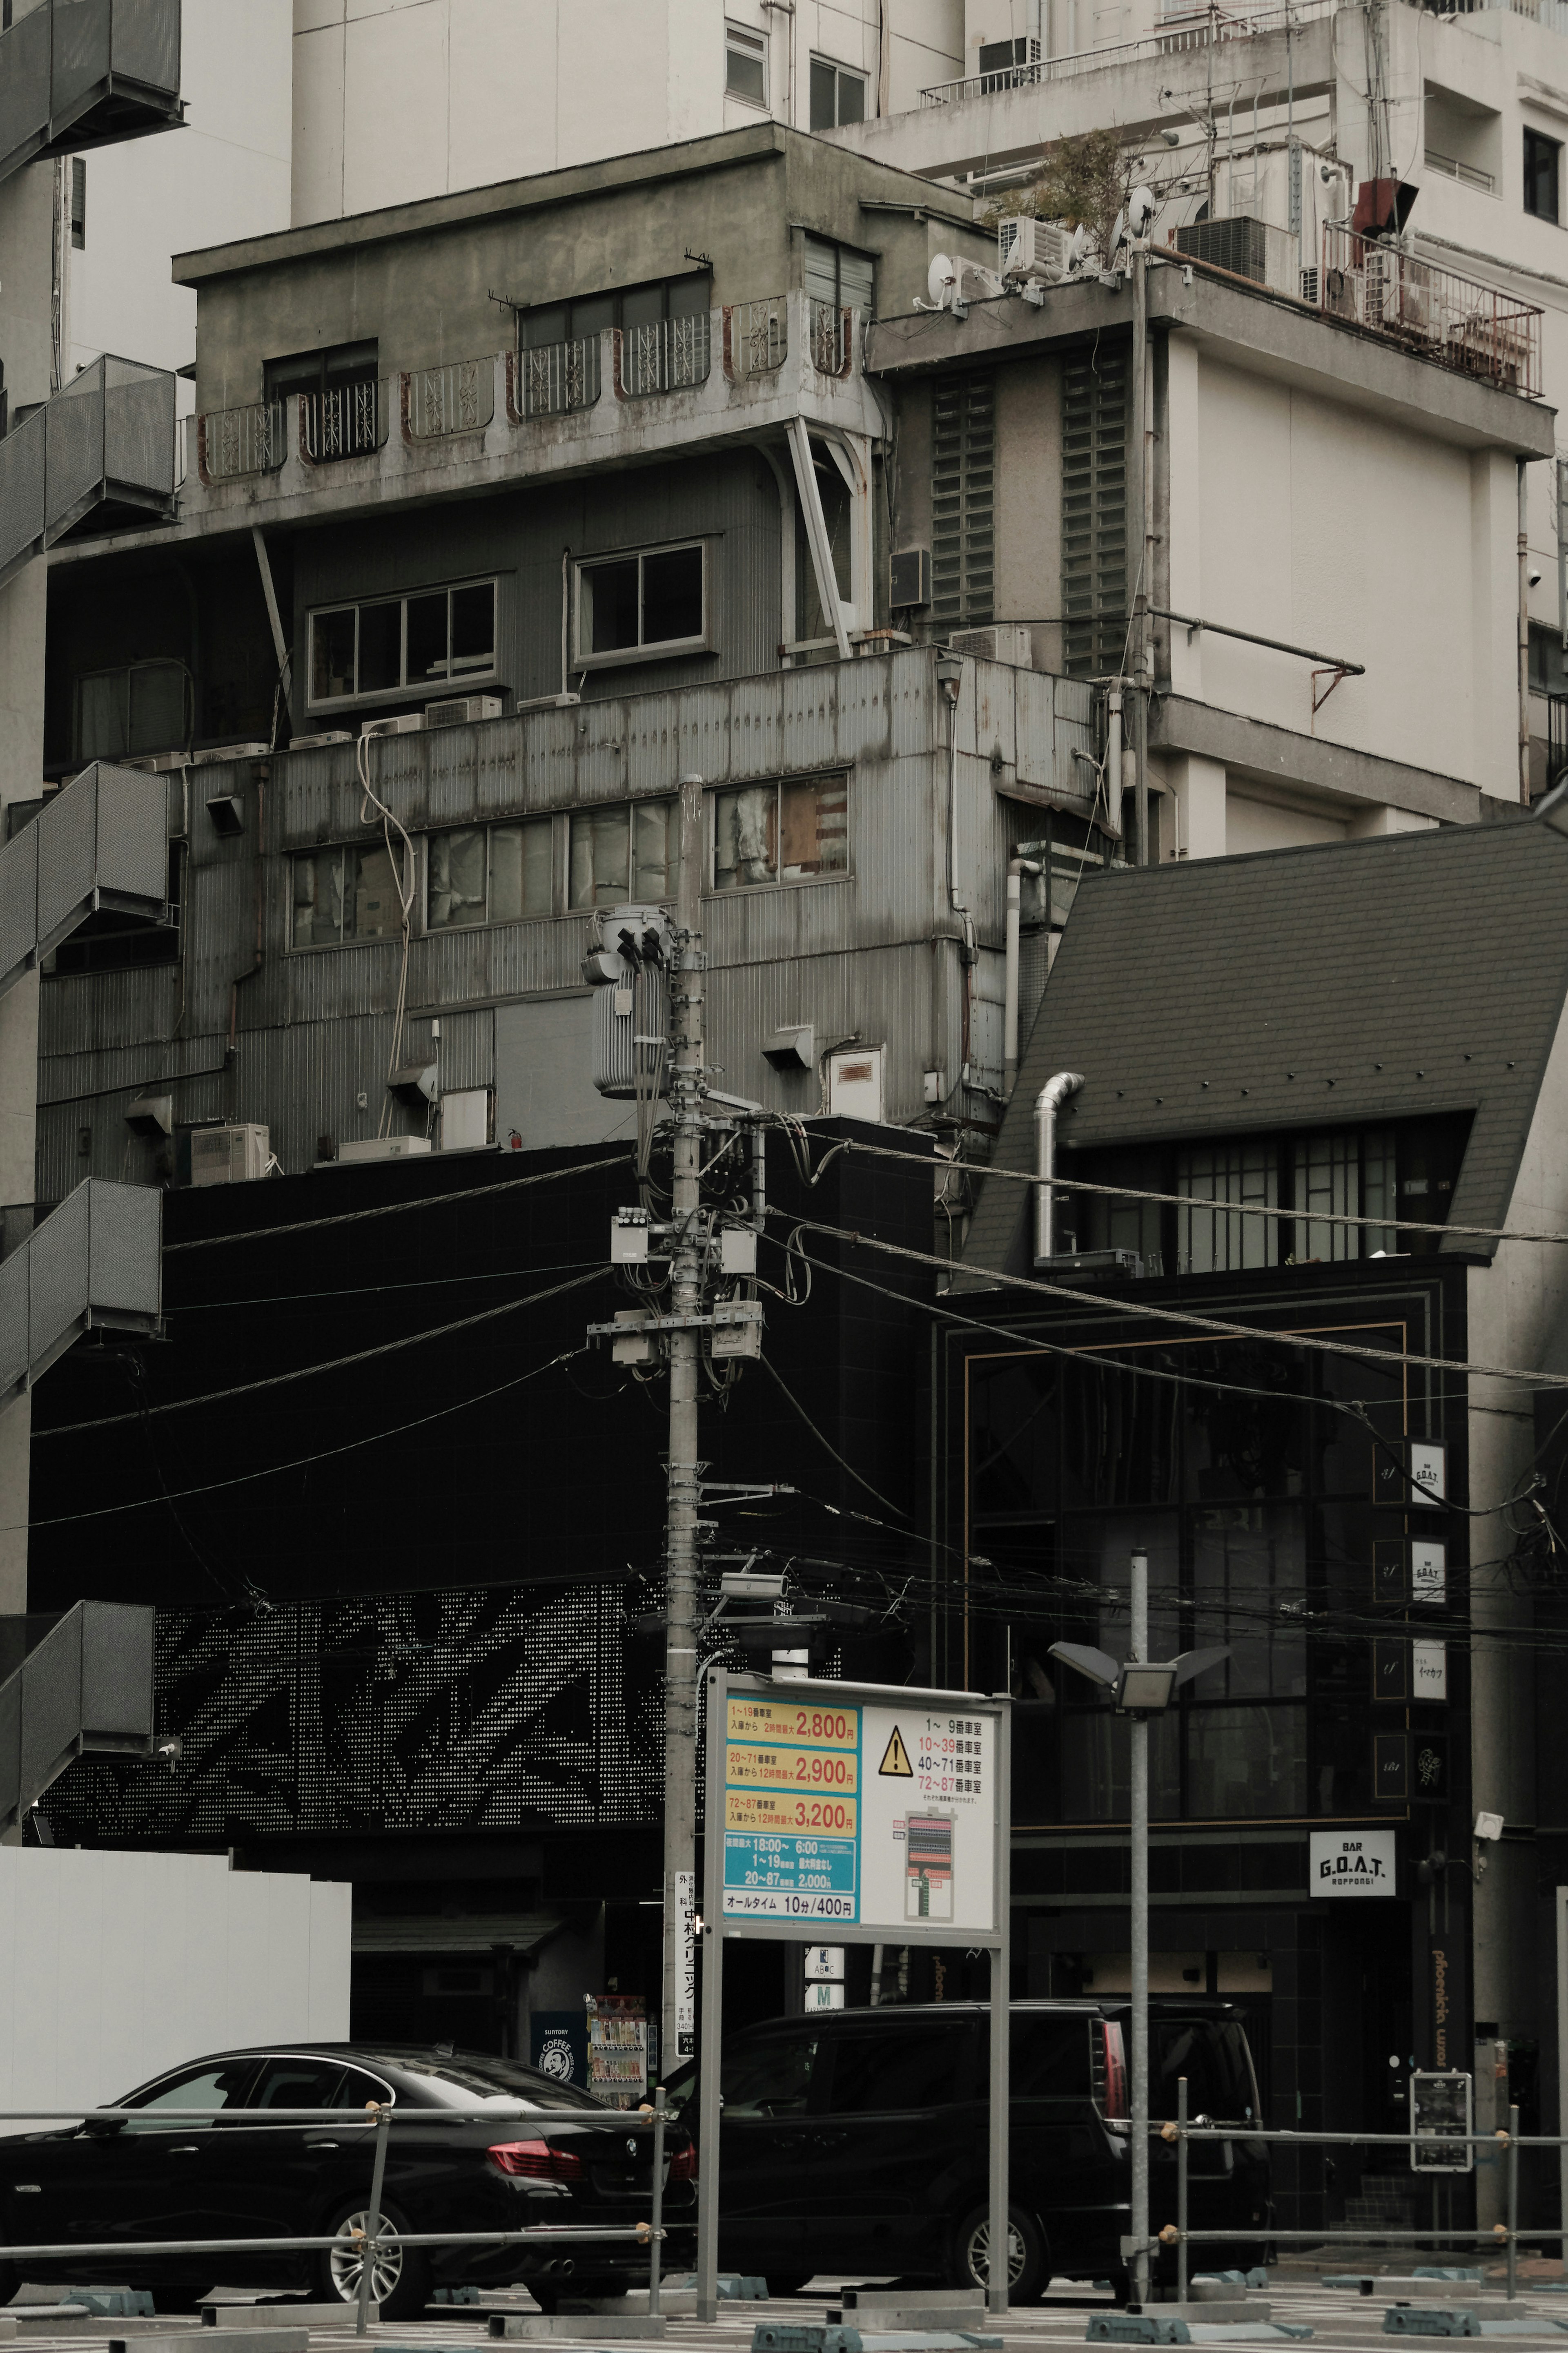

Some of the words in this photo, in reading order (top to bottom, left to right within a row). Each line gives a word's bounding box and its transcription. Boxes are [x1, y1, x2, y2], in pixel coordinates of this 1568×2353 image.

[731, 1720, 758, 1731] 入庫から
[797, 1712, 853, 1740] 2,800円
[731, 1766, 757, 1777] 入庫から
[796, 1757, 853, 1784] 2,900円
[730, 1812, 756, 1822] 入庫から
[795, 1802, 852, 1829] 3,200円
[1342, 1842, 1362, 1851] BAR
[1320, 1856, 1386, 1879] G.O.A.T.
[727, 1896, 776, 1909] オールタイム
[542, 2039, 571, 2053] COFFEE
